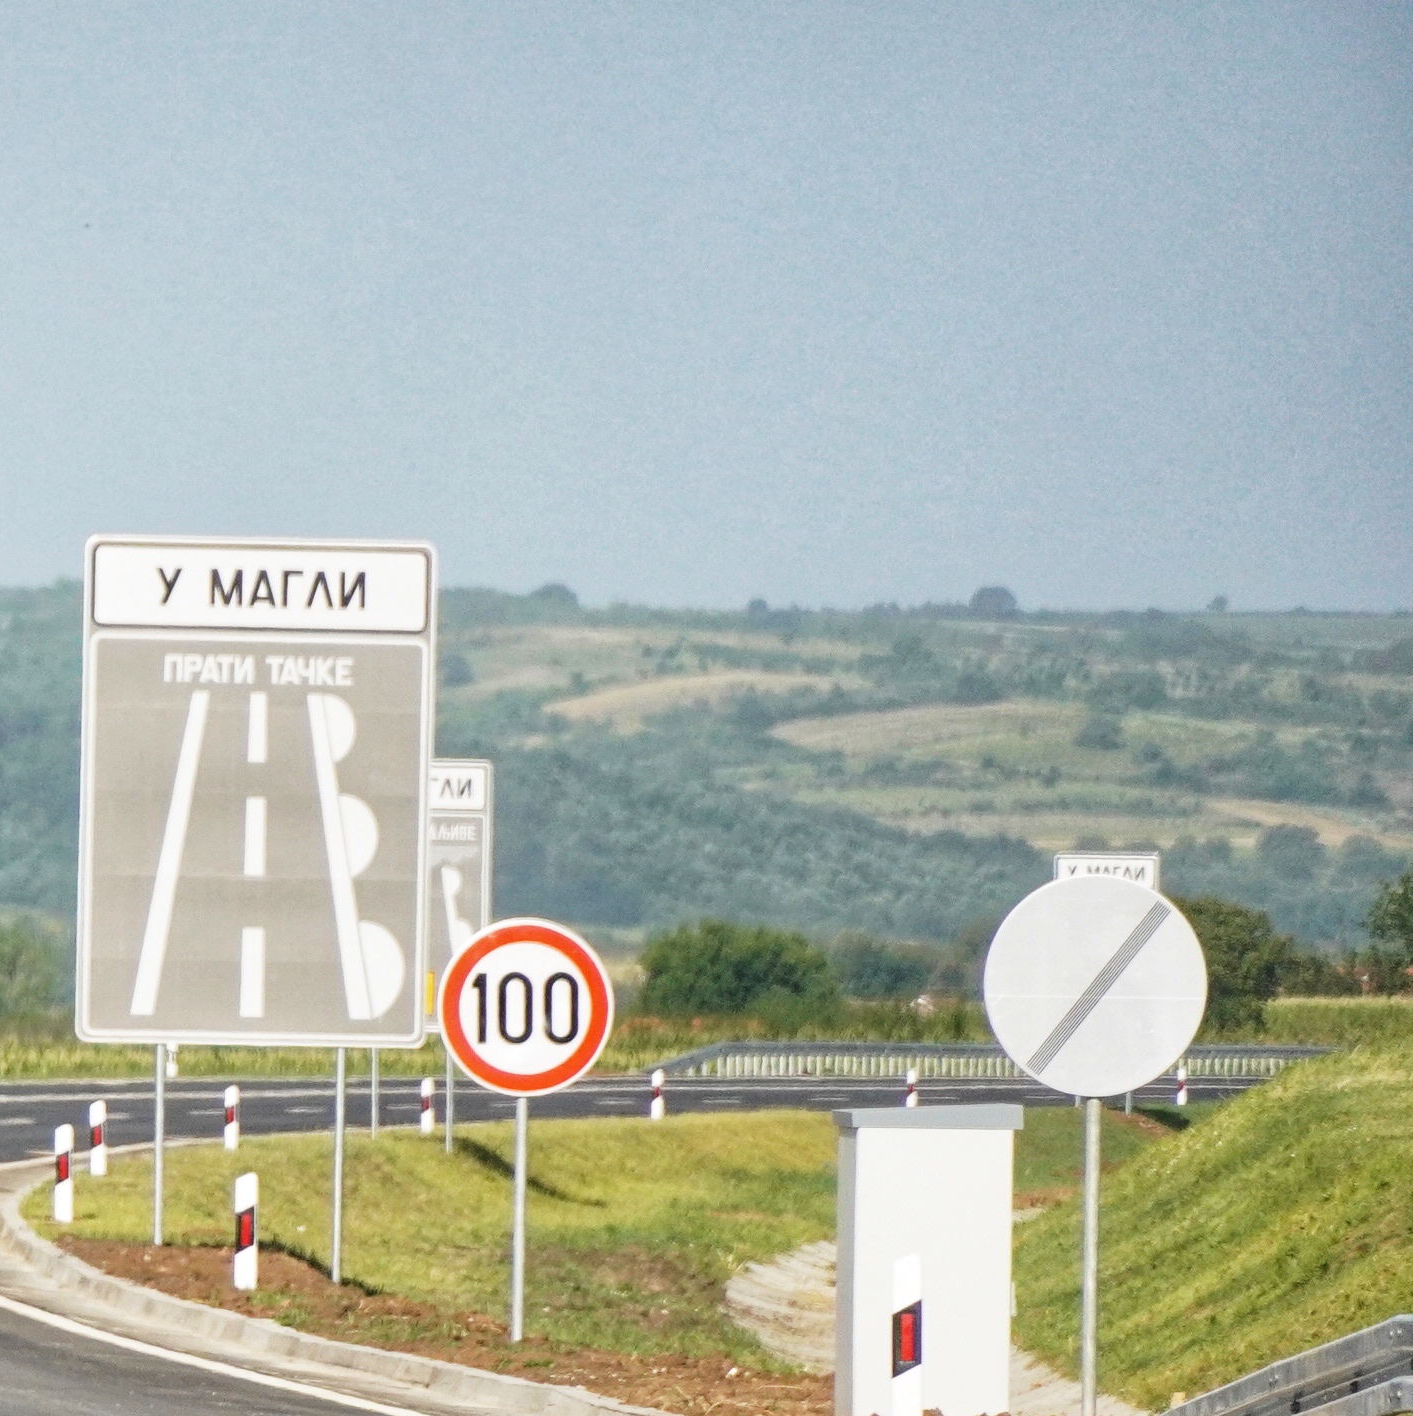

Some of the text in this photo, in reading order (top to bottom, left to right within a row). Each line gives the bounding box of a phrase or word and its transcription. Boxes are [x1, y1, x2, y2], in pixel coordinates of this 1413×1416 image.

[158, 568, 367, 610] У МАГЛИ
[163, 653, 355, 686] ПРАТИ ТАЧКЕ
[472, 971, 579, 1044] 100
